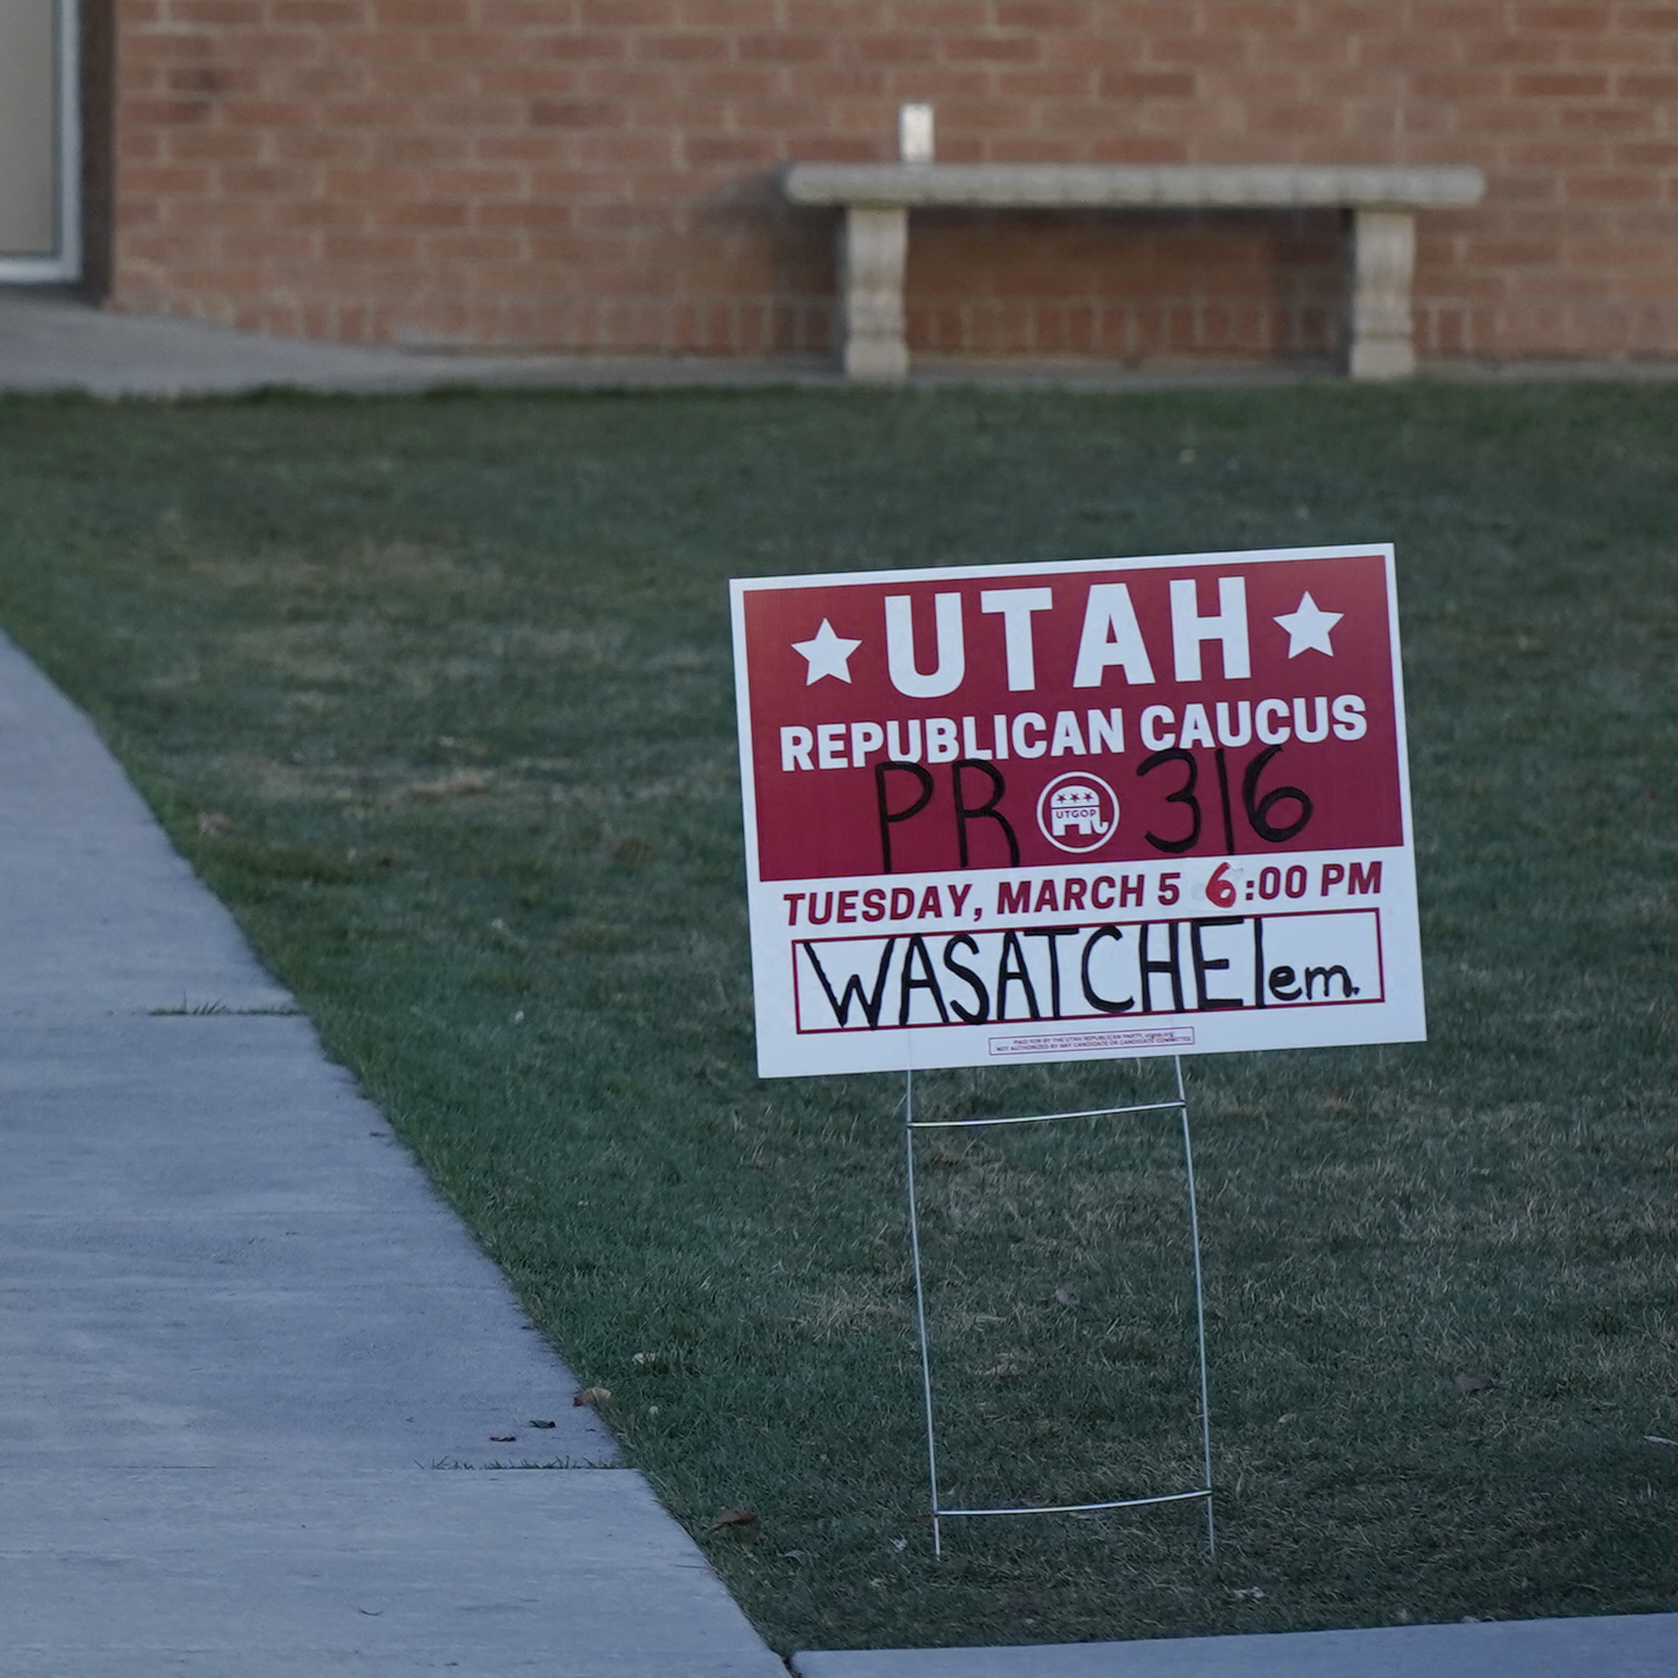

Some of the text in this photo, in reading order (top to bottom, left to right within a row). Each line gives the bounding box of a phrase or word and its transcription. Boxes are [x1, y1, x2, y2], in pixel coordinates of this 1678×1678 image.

[884, 576, 1251, 699] UTAH
[780, 694, 1367, 772] REPUBLICAN CAUCUS
[874, 744, 1313, 873] PR 316
[1055, 809, 1097, 819] UTGOP
[783, 861, 1382, 925] TUESDAY, MARCH 5 6:00 PM
